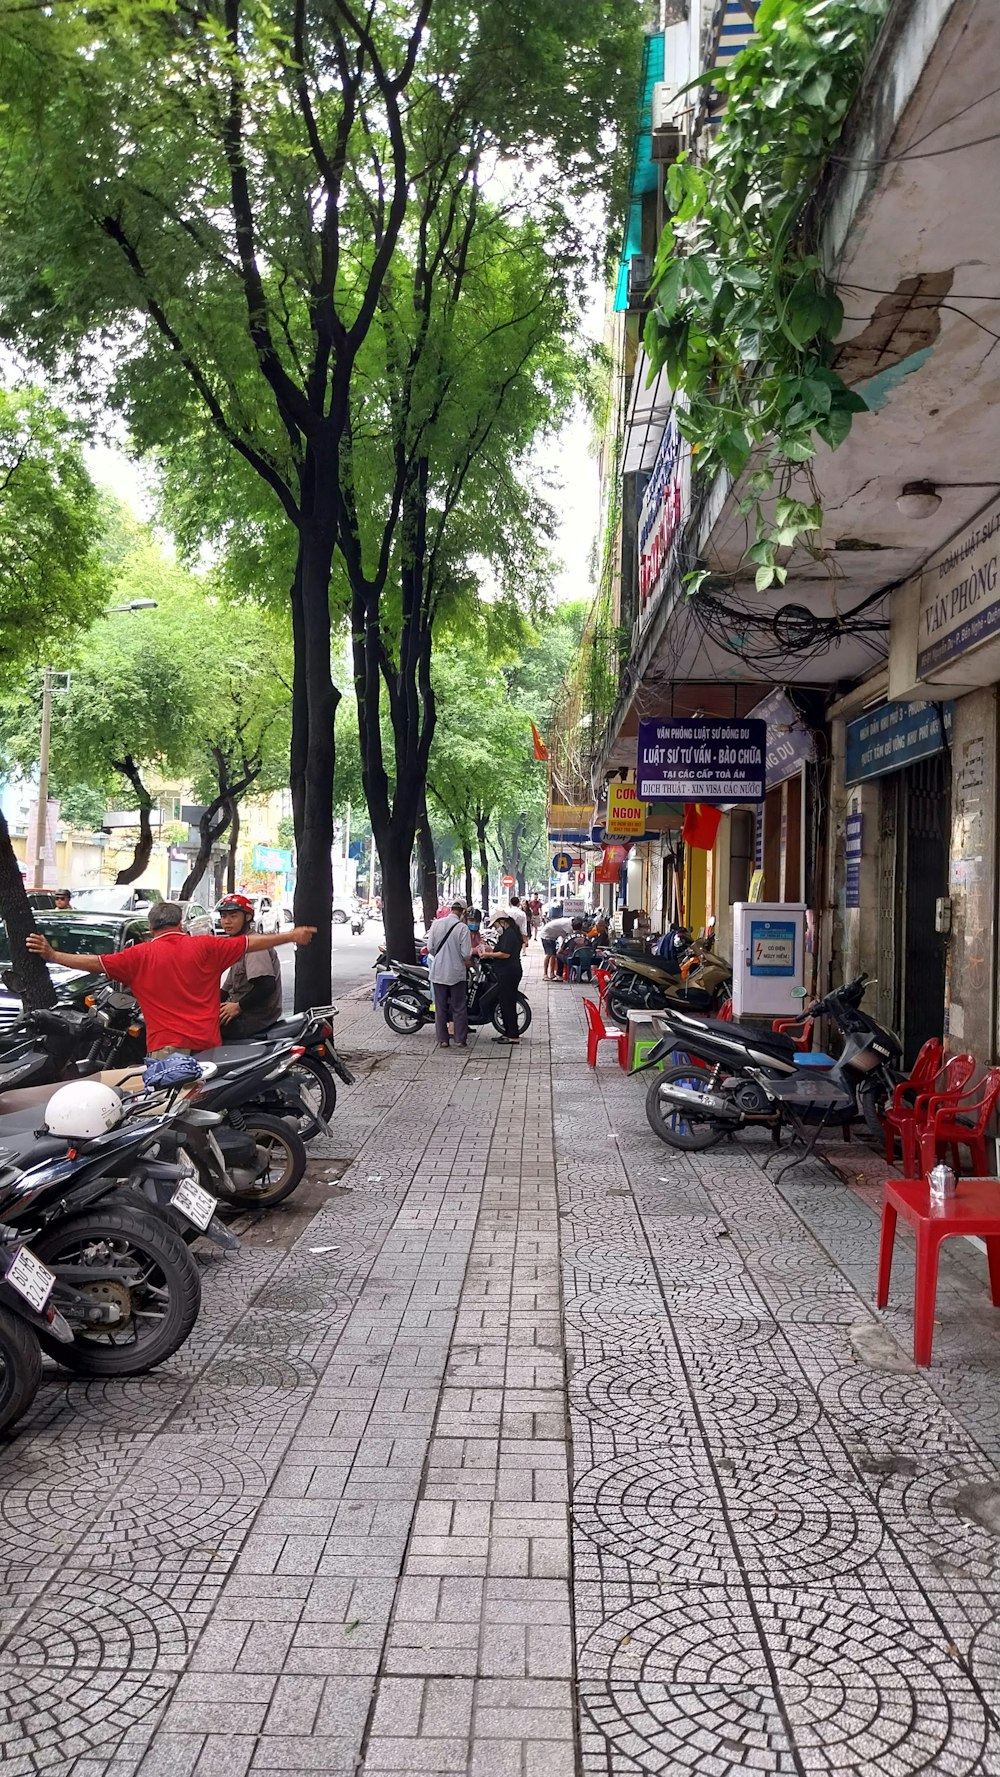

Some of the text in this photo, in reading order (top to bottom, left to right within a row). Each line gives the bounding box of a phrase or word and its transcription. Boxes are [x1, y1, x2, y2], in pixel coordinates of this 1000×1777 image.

[960, 531, 981, 561] LUẬT
[925, 556, 998, 636] VĂN PHÒNG
[657, 726, 671, 739] VĂN
[671, 726, 693, 740] PHÒNG
[694, 728, 710, 742] LUẬT
[712, 728, 722, 740] SƯ
[644, 745, 664, 766] LUẬT
[667, 748, 680, 764] SƯ
[680, 746, 693, 764] TƯ
[694, 744, 712, 764] VẤN
[718, 745, 736, 764] BÀO
[738, 746, 762, 764] CHỮA
[776, 741, 794, 760] DU
[663, 768, 746, 780] TẠI CÁC CẤP TOÀ ÁN
[644, 784, 661, 796] DỊCH
[662, 782, 686, 796] THUẬT
[692, 784, 704, 794] XIN
[706, 784, 722, 794] VISA
[724, 782, 738, 794] CÁC
[740, 782, 760, 794] NƯỚC
[612, 807, 641, 819] NGON
[872, 1042, 890, 1058] YAMAHA
[190, 1192, 214, 1226] 740.54
[26, 1265, 52, 1308] 324.08
